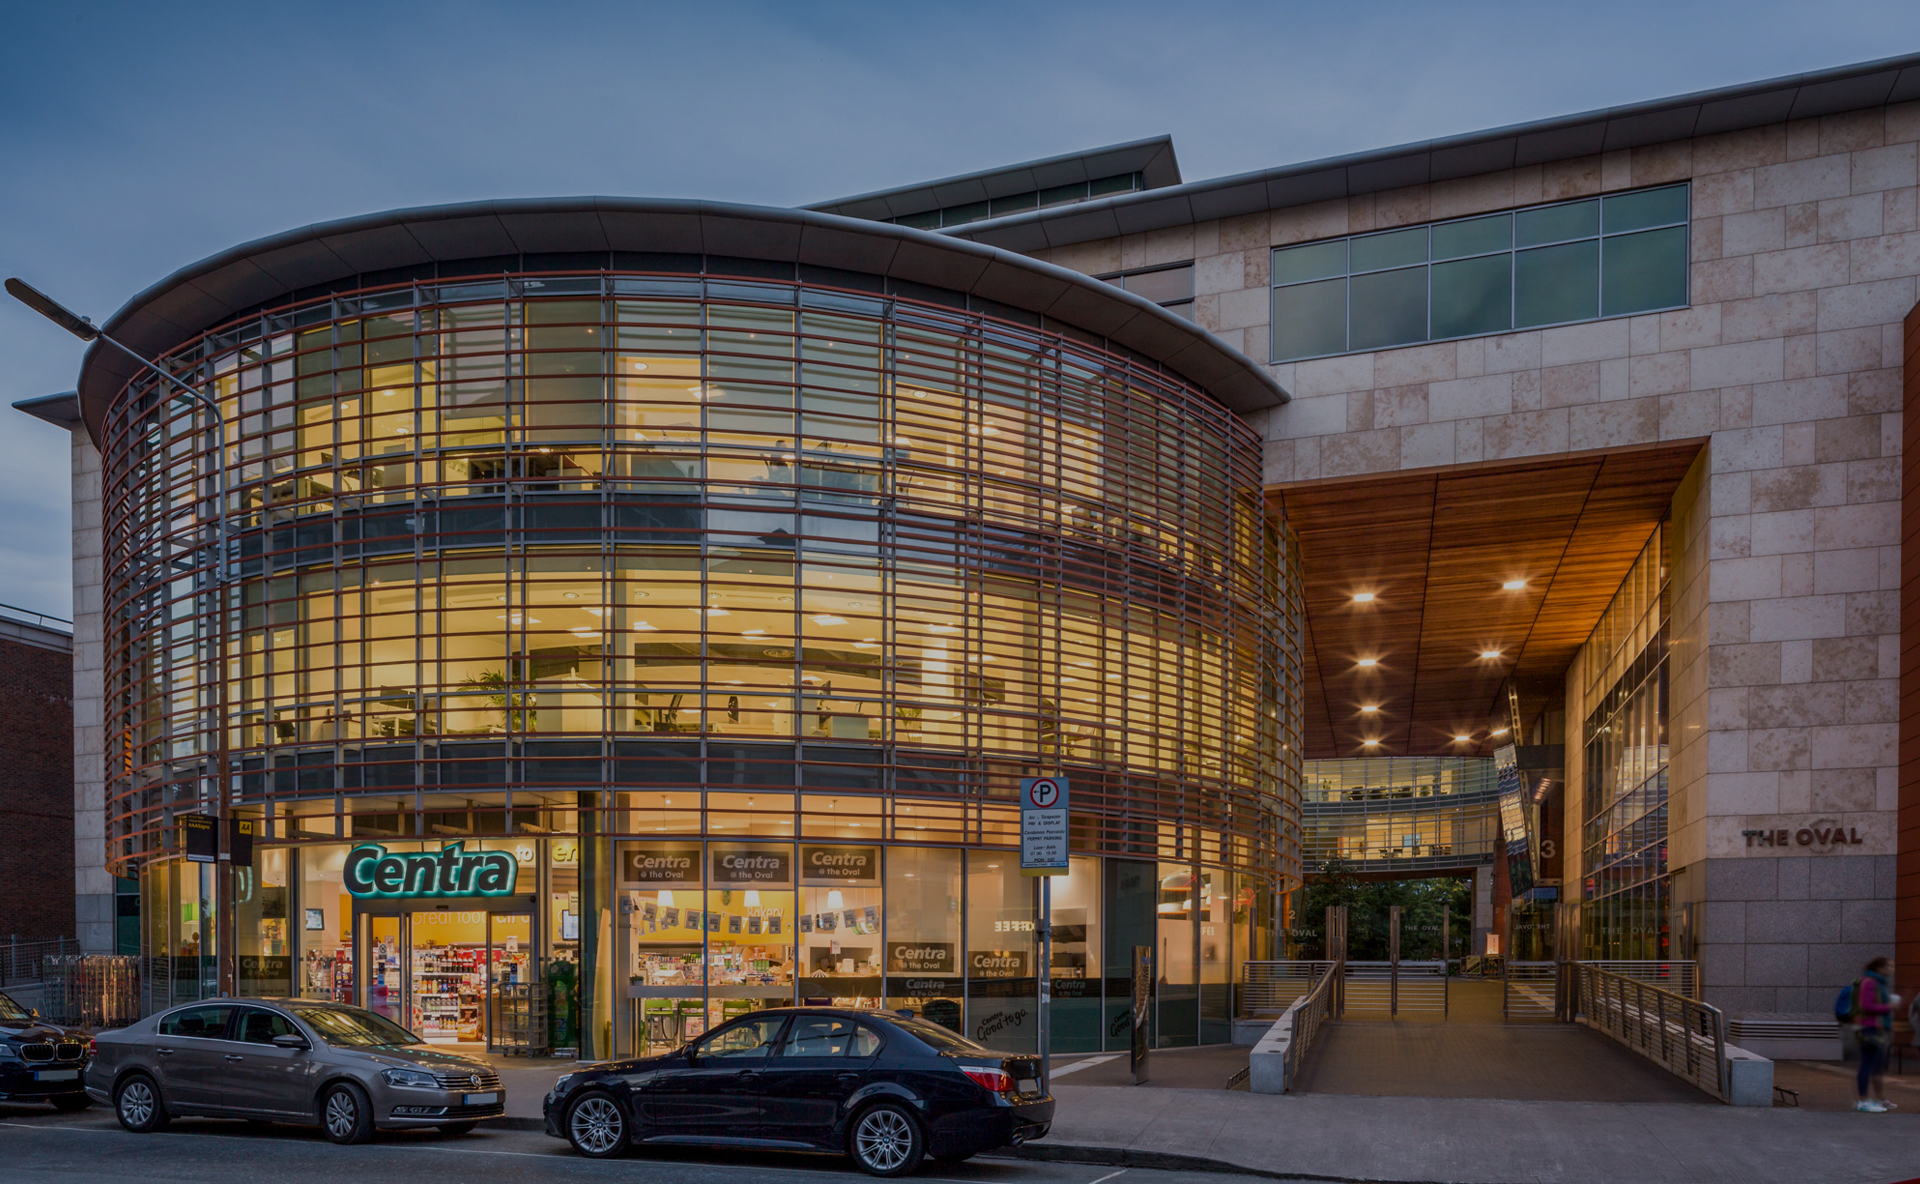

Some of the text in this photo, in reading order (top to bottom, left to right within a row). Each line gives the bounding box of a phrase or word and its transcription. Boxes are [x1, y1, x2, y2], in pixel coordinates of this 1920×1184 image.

[1039, 784, 1051, 802] P
[241, 823, 250, 831] AA
[1741, 827, 1863, 847] THE OVAL
[1540, 839, 1556, 859] 3
[632, 854, 691, 869] Centra
[722, 854, 780, 869] Centra
[811, 851, 867, 866] Centra
[344, 842, 516, 896] Centra
[649, 870, 662, 879] the
[665, 870, 684, 879] Oval
[738, 870, 752, 879] the
[754, 871, 773, 879] Oval
[827, 867, 841, 875] the
[842, 867, 860, 876] Oval
[747, 904, 785, 921] Bakery
[1288, 910, 1296, 920] 2
[1291, 929, 1318, 937] OVAL
[1601, 926, 1661, 935] THE OVAL
[895, 946, 946, 960] Centra
[909, 961, 922, 969] the
[923, 961, 940, 969] Oval
[974, 954, 1021, 968] Centra
[985, 969, 998, 977] the
[998, 969, 1015, 977] Oval
[906, 979, 945, 990] Centra
[1054, 979, 1086, 990] Centra
[981, 1010, 1003, 1026] Centra
[977, 1018, 1004, 1042] Good
[1003, 1014, 1014, 1027] to
[1110, 1016, 1131, 1038] Good
